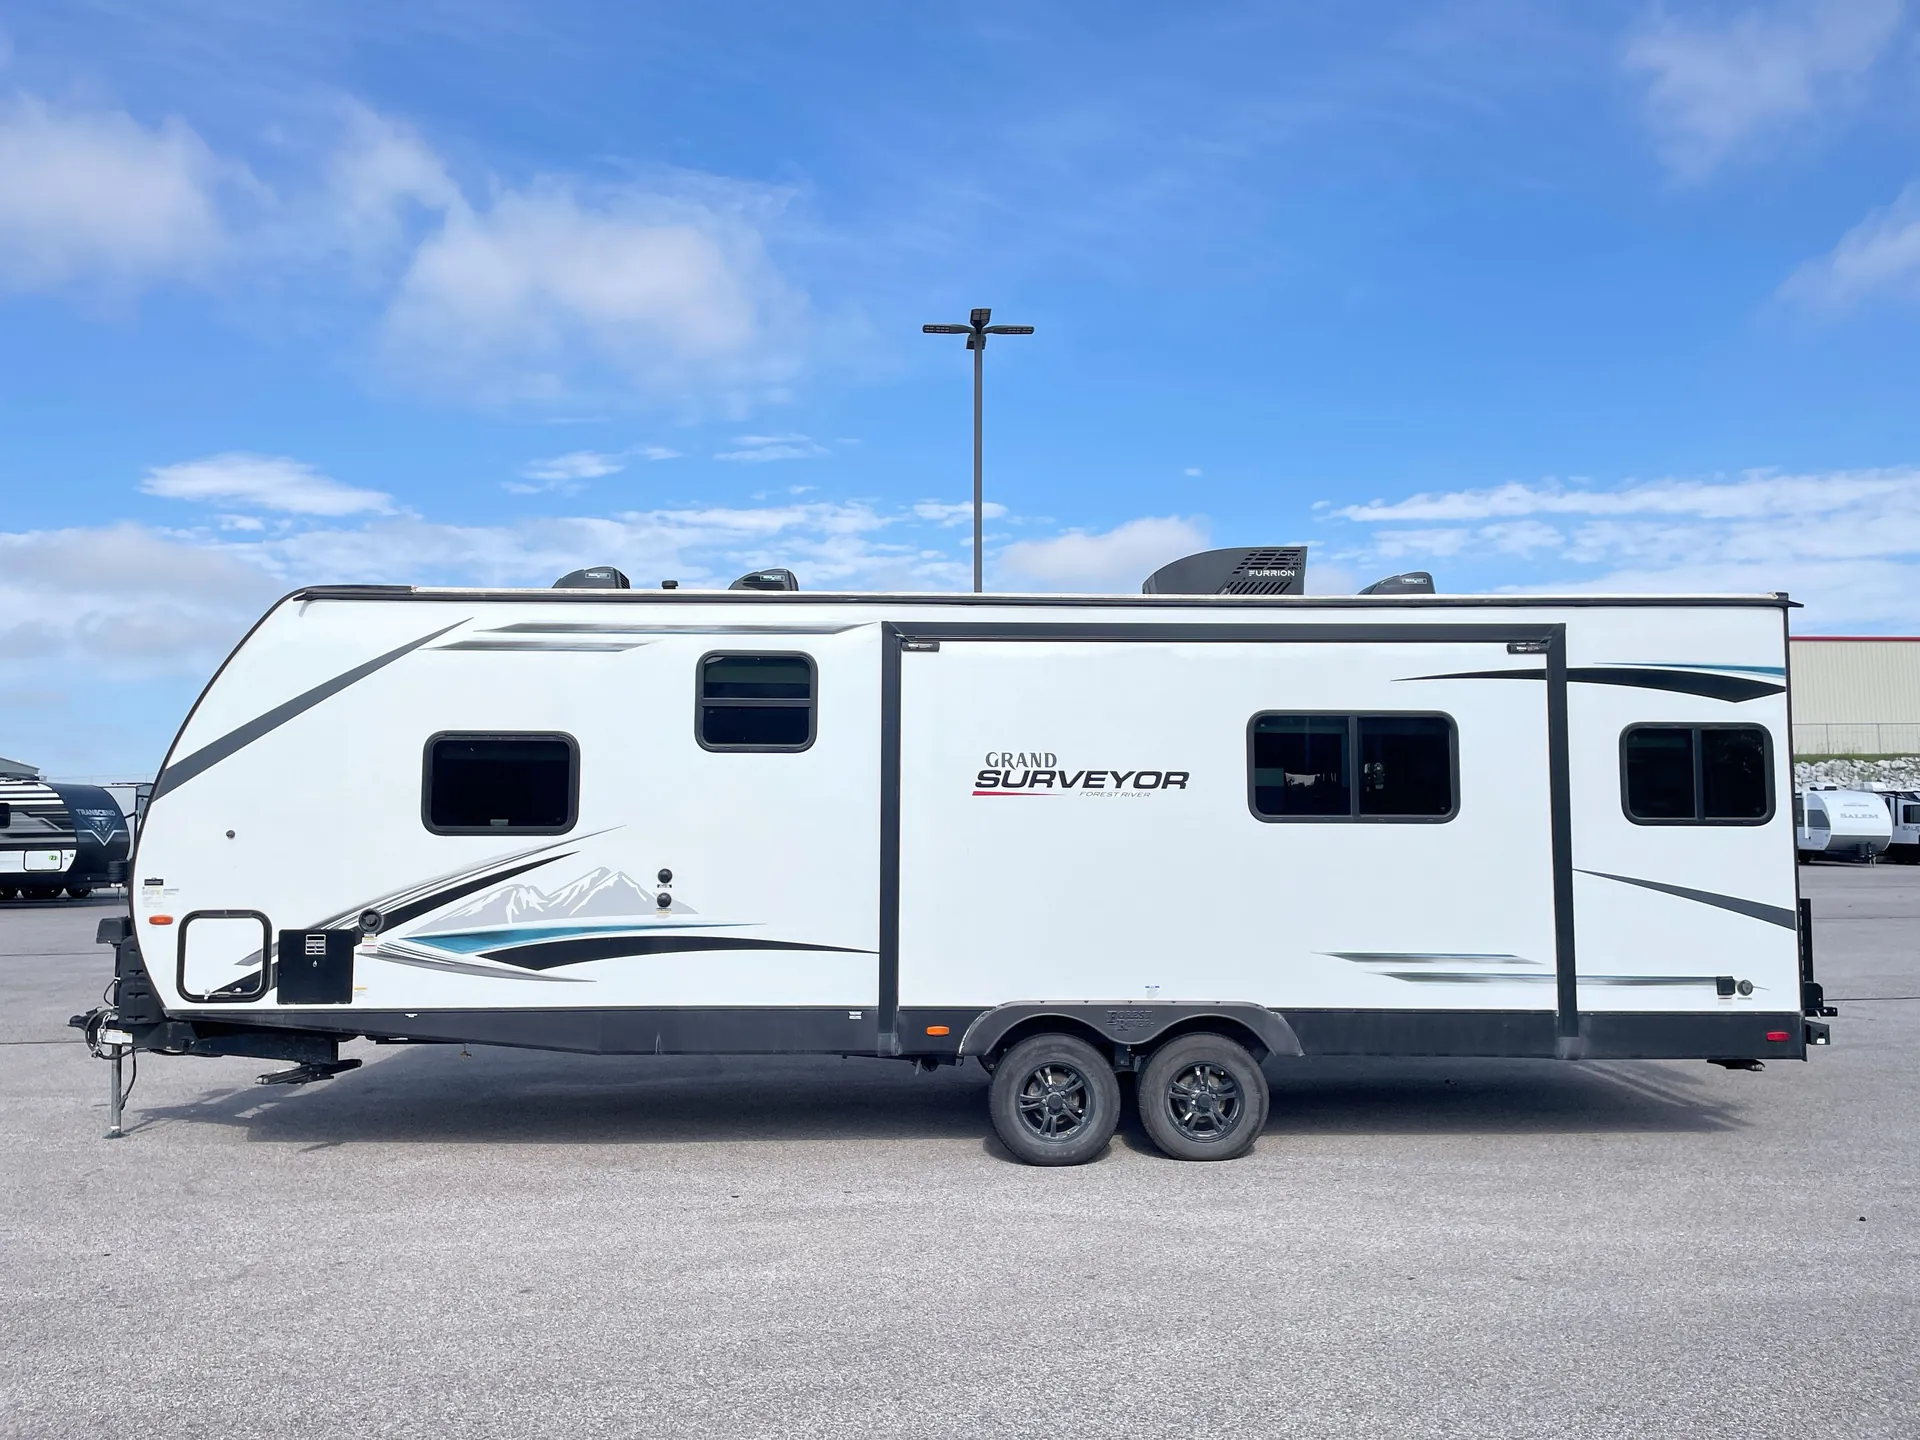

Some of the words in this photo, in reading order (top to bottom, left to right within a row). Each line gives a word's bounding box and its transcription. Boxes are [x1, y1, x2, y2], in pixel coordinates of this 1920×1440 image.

[1248, 569, 1295, 577] FURRION
[985, 752, 1057, 769] GRAND
[975, 769, 1190, 789] SURVEYOR
[76, 808, 116, 816] TRANSCEND
